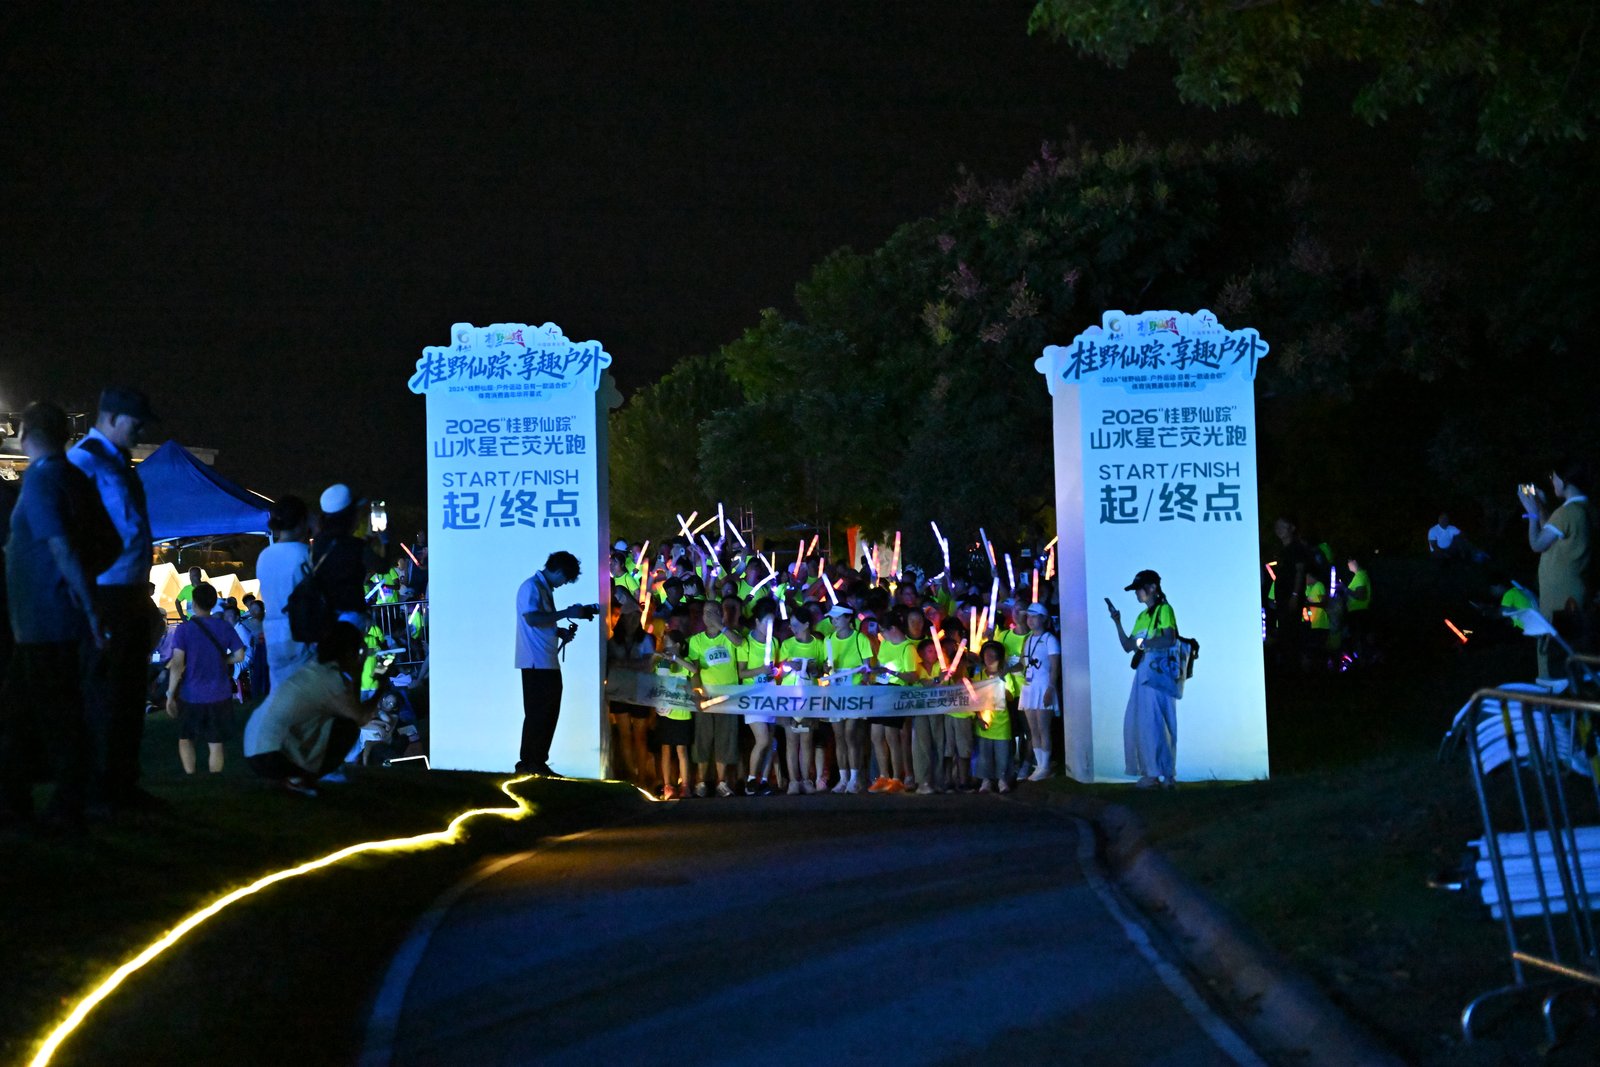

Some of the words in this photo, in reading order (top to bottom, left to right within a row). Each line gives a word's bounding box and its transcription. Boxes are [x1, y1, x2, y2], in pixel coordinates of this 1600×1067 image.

[434, 434, 586, 458] 山水星芒荧光跑
[1090, 425, 1247, 450] 山水星芒荧光跑
[442, 469, 579, 487] START/FNISH
[1099, 461, 1240, 481] START/FNISH
[442, 489, 581, 530] 起/终点
[1100, 482, 1243, 524] 起/终点
[738, 694, 874, 711] START/FINISH
